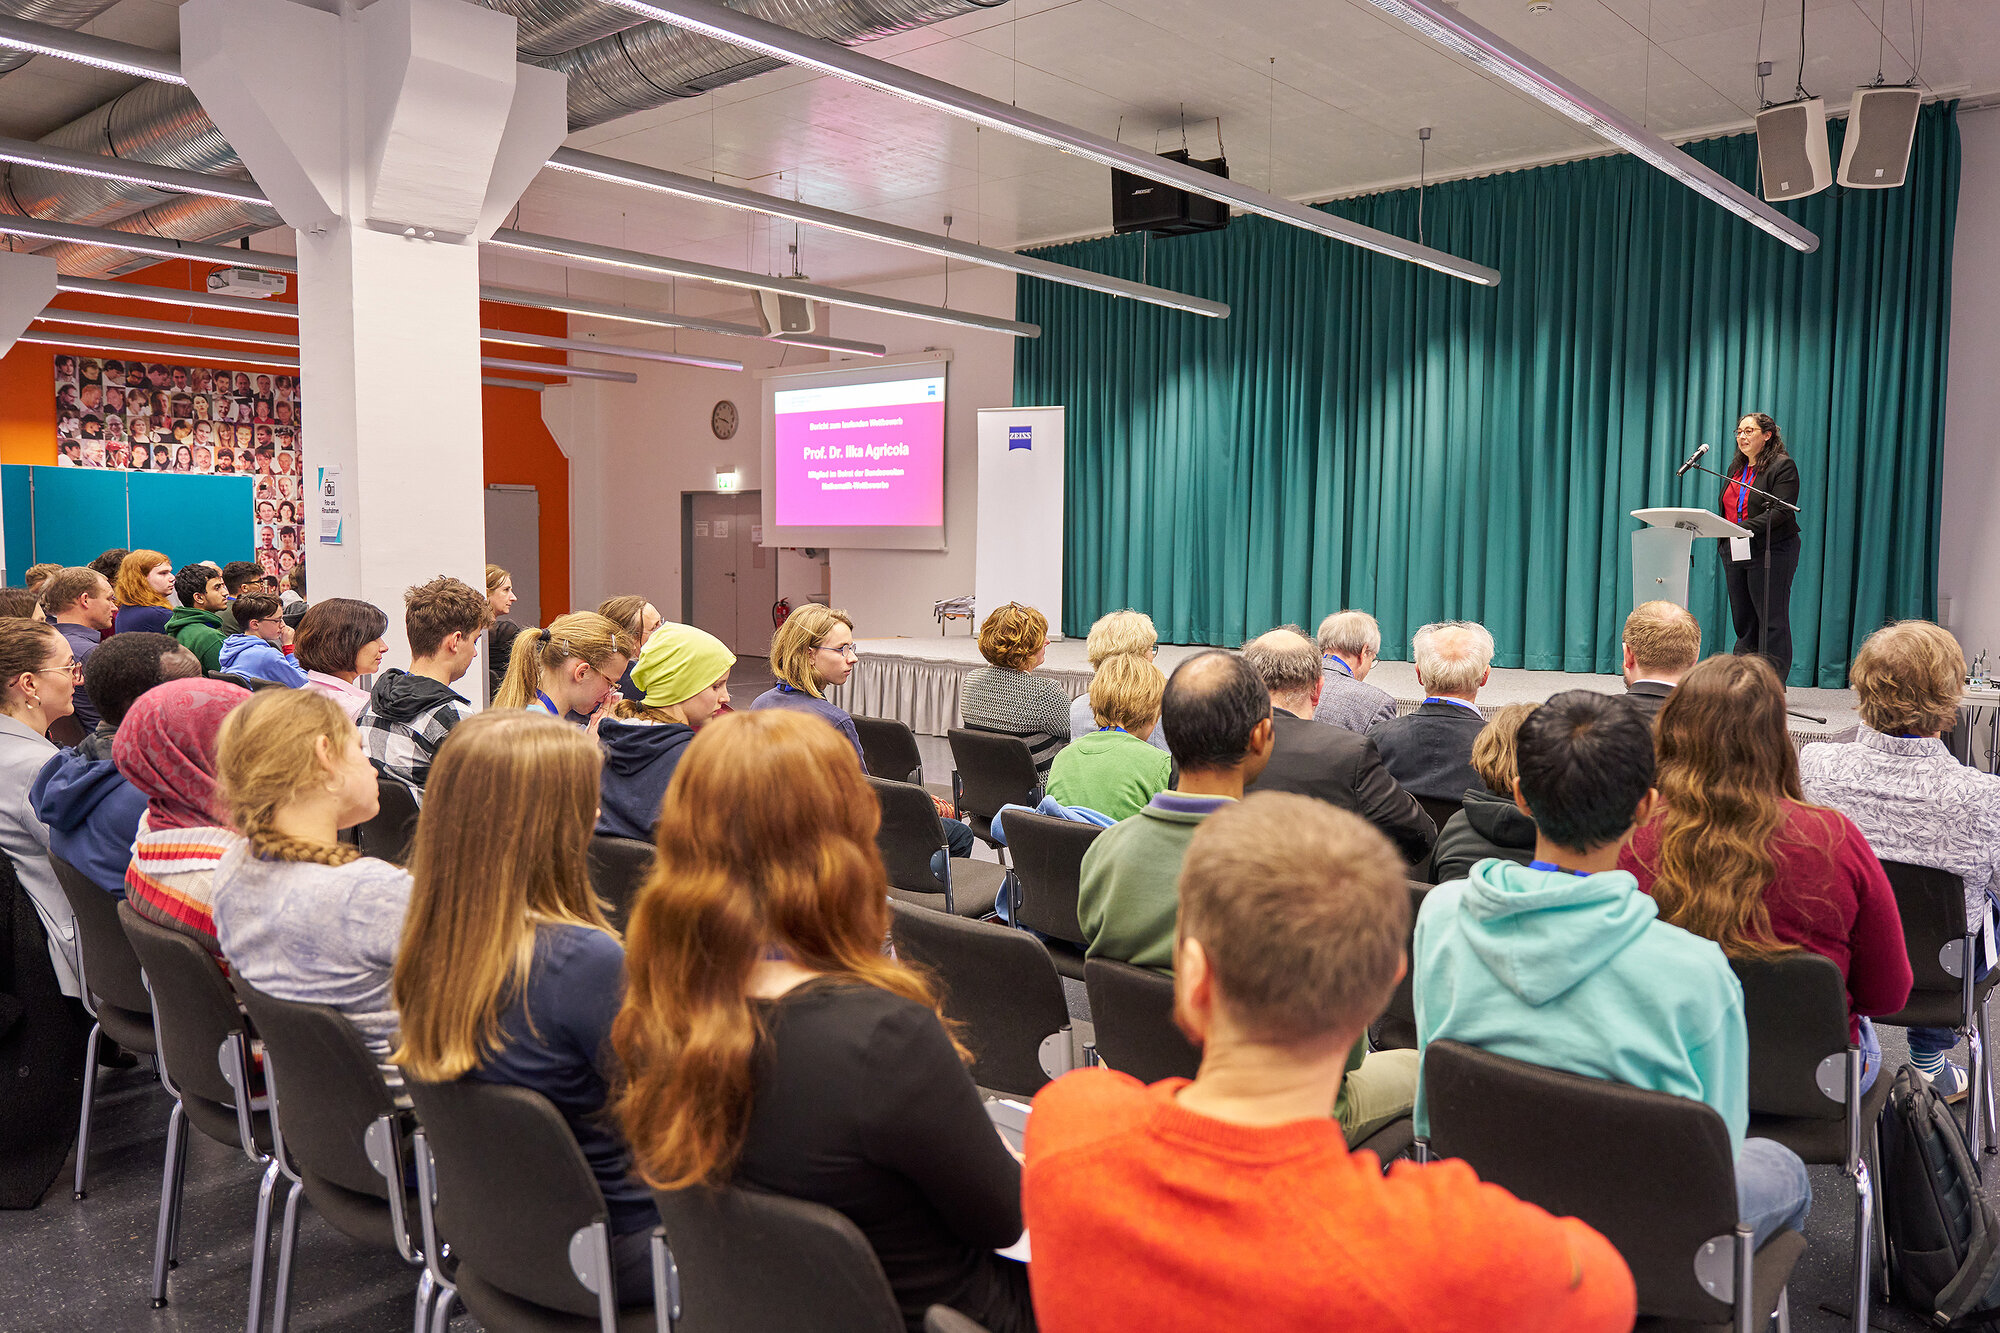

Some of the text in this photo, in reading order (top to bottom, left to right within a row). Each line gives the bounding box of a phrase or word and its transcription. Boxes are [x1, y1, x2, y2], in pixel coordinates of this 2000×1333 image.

[829, 422, 841, 430] zum
[869, 417, 904, 427] Wettbewerb
[1009, 432, 1032, 440] ZEISS
[803, 442, 910, 460] Prof. Dr. Ilka Agricola
[854, 469, 864, 478] der
